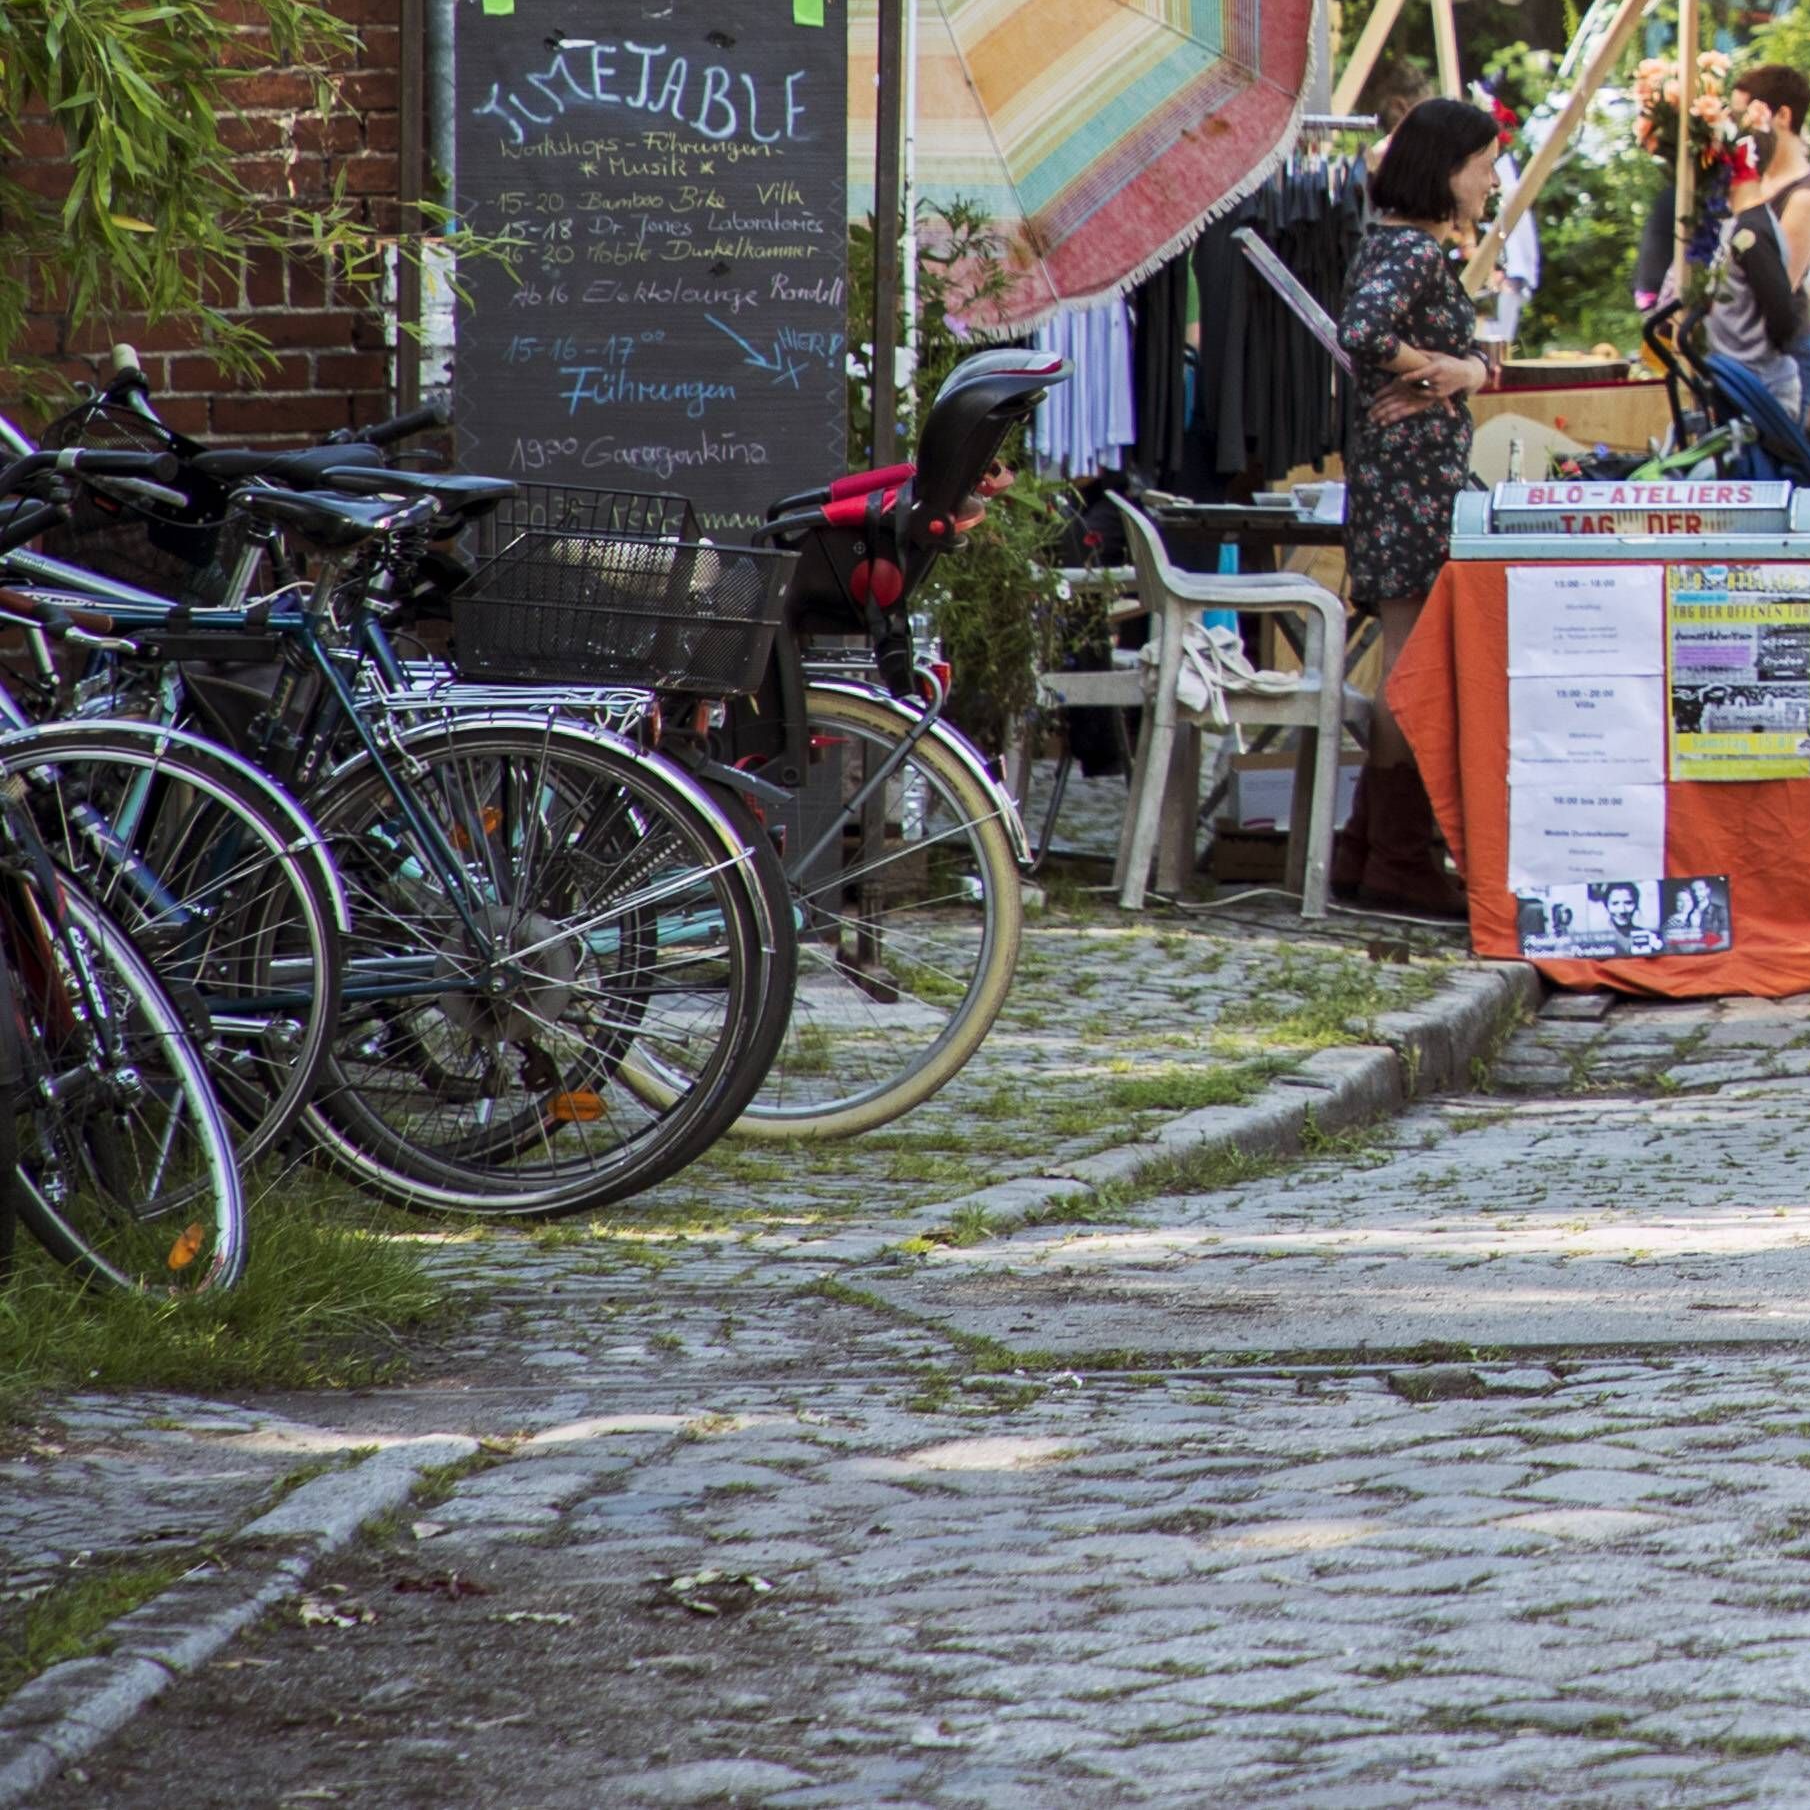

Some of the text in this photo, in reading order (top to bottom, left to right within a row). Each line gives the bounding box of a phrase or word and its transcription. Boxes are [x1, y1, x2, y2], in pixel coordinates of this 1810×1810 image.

[472, 40, 814, 146] TIMETABLE
[608, 158, 688, 178] Musik
[576, 191, 664, 211] Bamboo
[669, 186, 727, 213] Bike
[756, 181, 805, 205] Villa
[588, 214, 625, 236] Dr.
[631, 213, 692, 241] Jones
[586, 241, 650, 266] Mobile
[558, 366, 736, 419] Führungen
[1559, 513, 1703, 534] TAG DER
[1673, 605, 1696, 619] TAG
[1699, 605, 1723, 618] DER
[1728, 604, 1783, 618] OFFENEN
